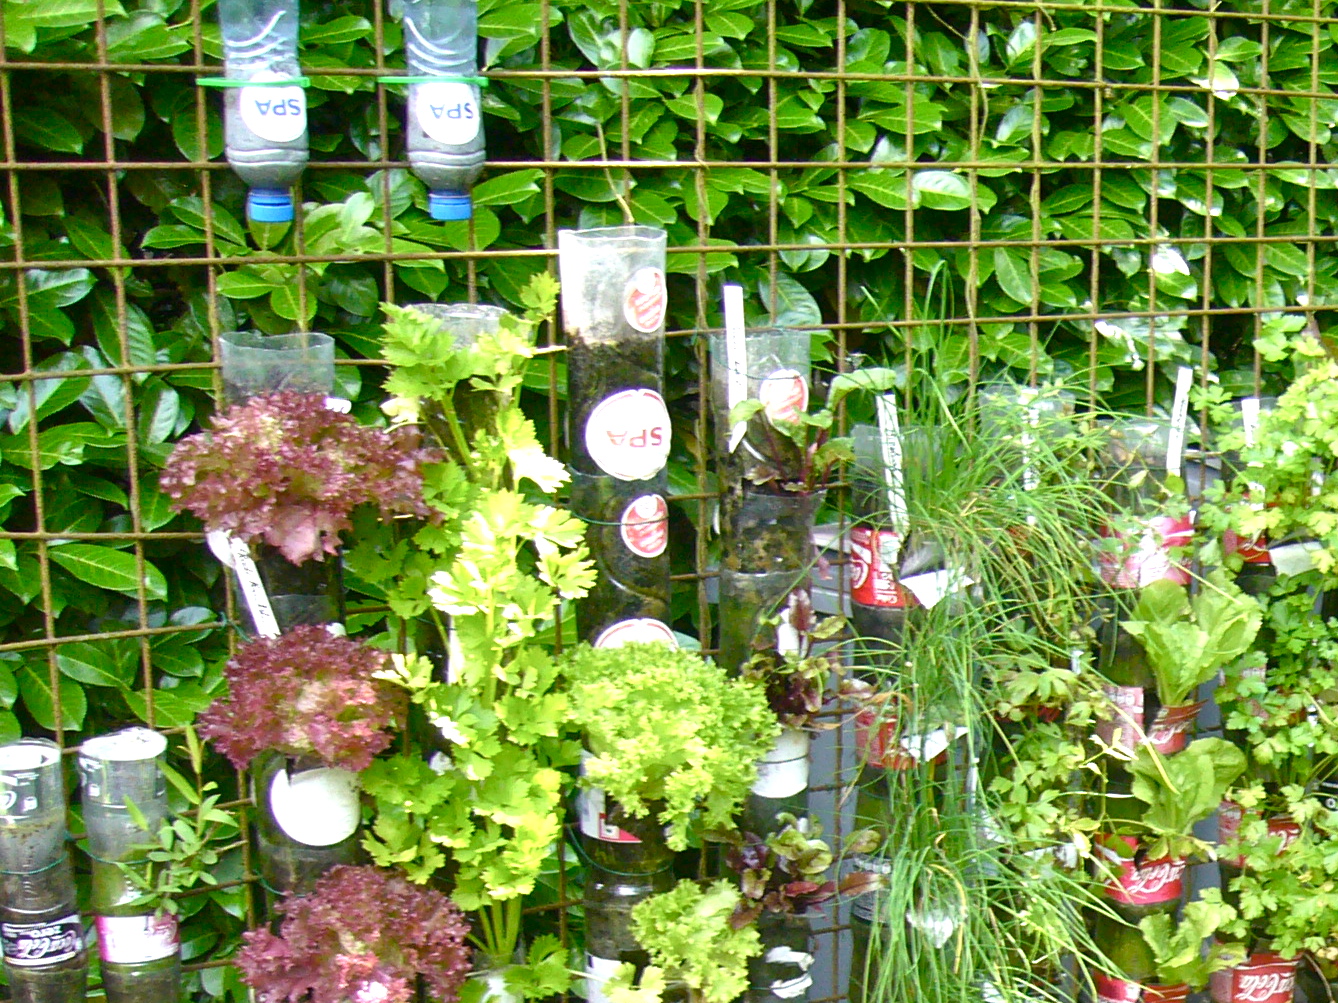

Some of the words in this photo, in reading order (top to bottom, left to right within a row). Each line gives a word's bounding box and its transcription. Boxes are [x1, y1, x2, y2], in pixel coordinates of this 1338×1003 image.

[255, 100, 301, 116] SPA
[430, 103, 474, 119] SPA
[607, 427, 663, 447] SPA
